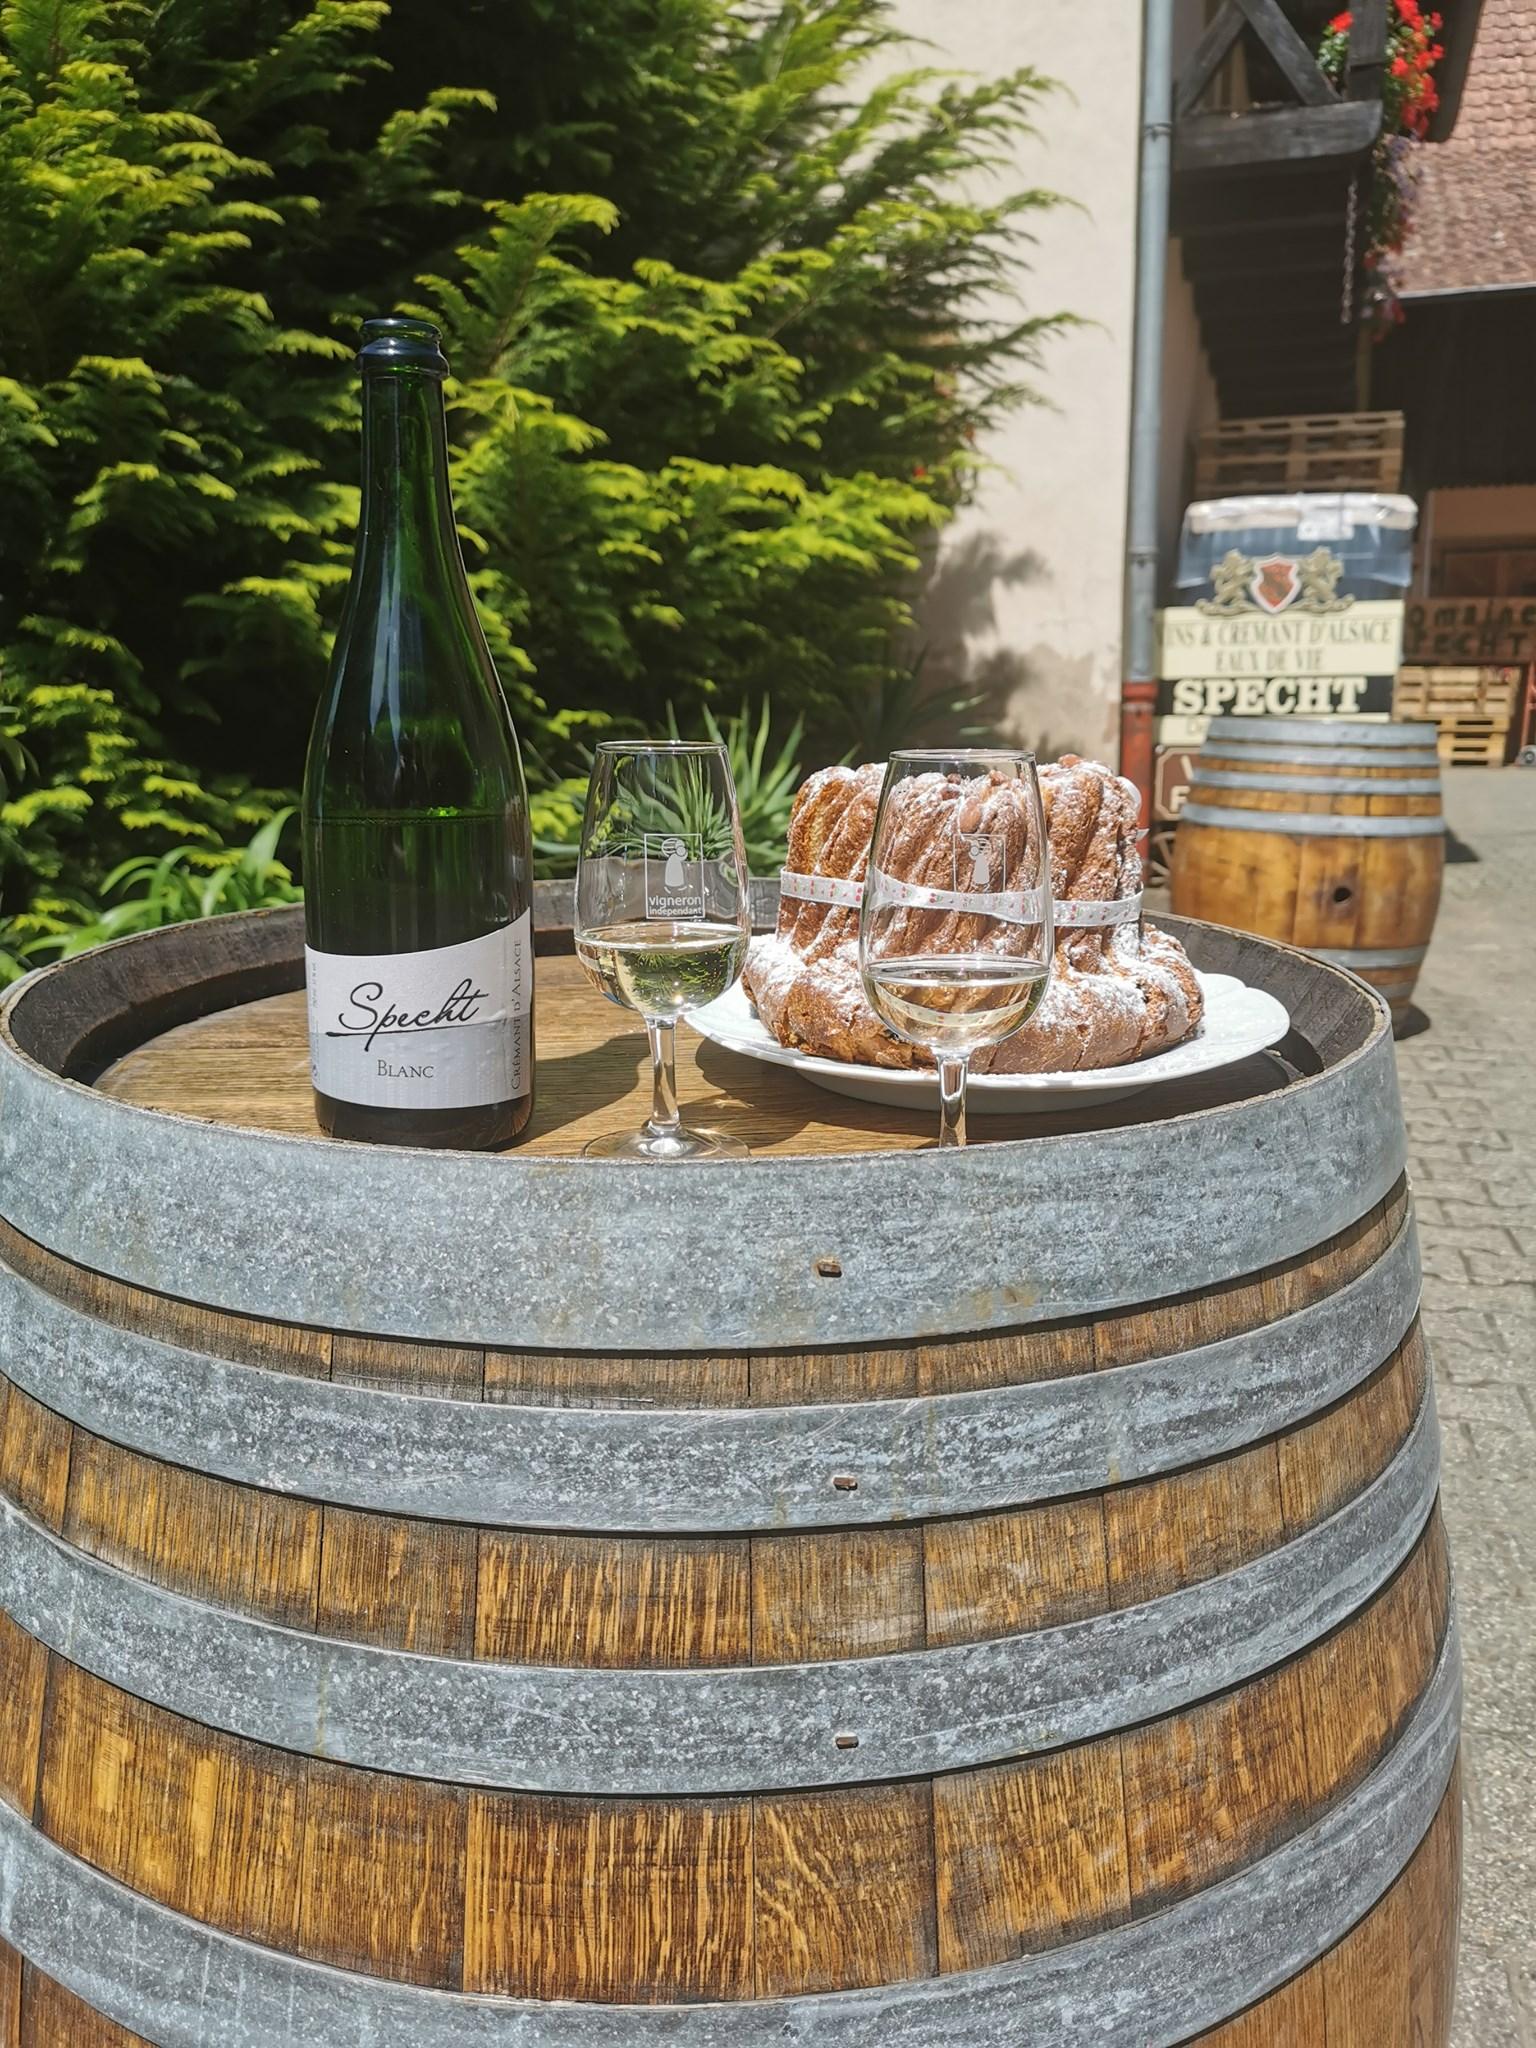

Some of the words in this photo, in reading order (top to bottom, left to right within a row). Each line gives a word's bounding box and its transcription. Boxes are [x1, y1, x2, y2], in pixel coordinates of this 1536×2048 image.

[1309, 618, 1392, 642] D'ALSACE
[1215, 650, 1260, 672] EAUX
[1266, 649, 1286, 671] DE
[1294, 647, 1324, 671] VIE
[1173, 676, 1368, 715] SPECHT
[648, 895, 702, 909] vigneron
[338, 977, 489, 1052] Specht
[376, 1059, 435, 1078] BLANC
